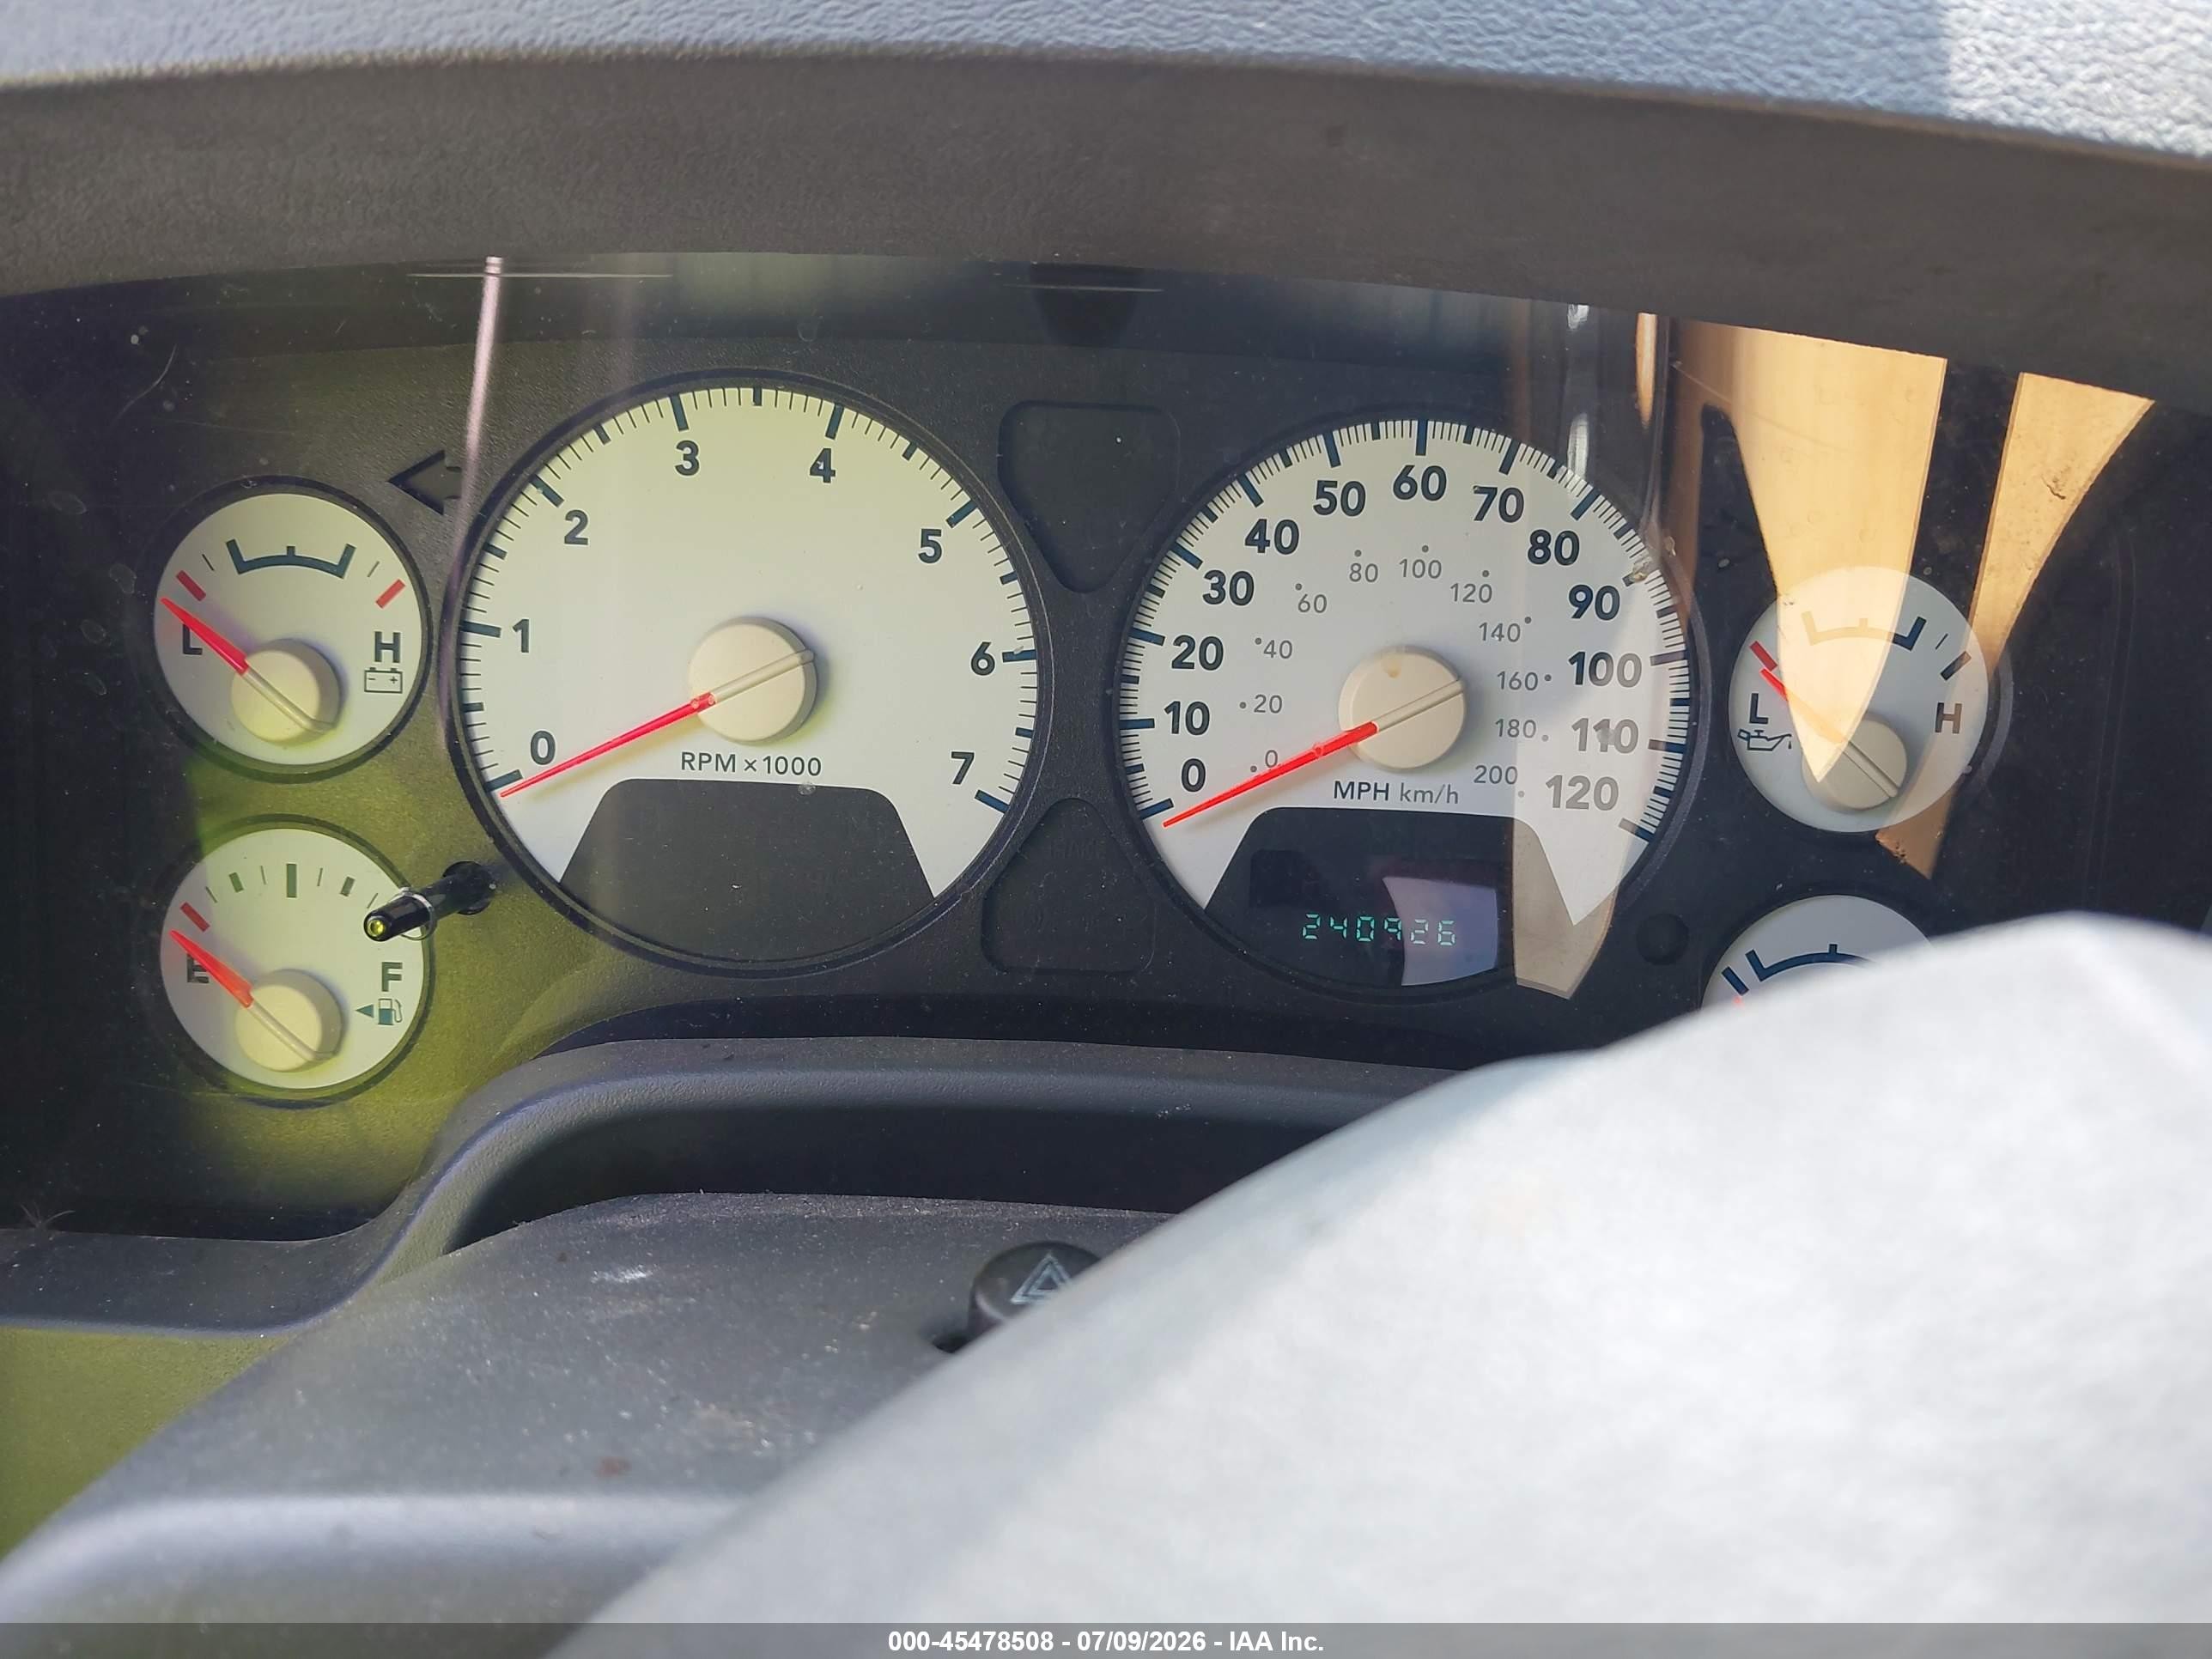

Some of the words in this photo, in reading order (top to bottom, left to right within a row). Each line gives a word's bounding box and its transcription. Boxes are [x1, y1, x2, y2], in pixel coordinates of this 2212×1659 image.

[675, 440, 700, 476] 3
[809, 448, 836, 483] 4
[1313, 480, 1366, 516] 50
[1393, 465, 1447, 501] 60
[1473, 486, 1524, 523] 70
[564, 509, 589, 545] 2
[1244, 519, 1299, 554] 40
[918, 528, 943, 563] 5
[1527, 530, 1580, 565] 80
[1349, 562, 1379, 584] 80
[1399, 559, 1442, 580] 100
[1203, 569, 1255, 605] 30
[1297, 593, 1328, 614] 60
[1449, 582, 1493, 604] 120
[1568, 585, 1620, 621] 90
[182, 625, 203, 656] L
[374, 631, 401, 663] H
[512, 617, 530, 653] 1
[1263, 639, 1293, 660] 40
[1479, 623, 1522, 643] 140
[971, 641, 996, 676] 6
[1171, 635, 1224, 671] 20
[1568, 651, 1642, 688] 100
[1496, 671, 1538, 692] 160
[1164, 701, 1211, 736] 10
[1253, 694, 1284, 714] 20
[1750, 692, 1769, 724] L
[1935, 702, 1963, 734] H
[1495, 719, 1536, 739] 180
[1571, 717, 1639, 754] 110
[530, 730, 556, 765] 0
[681, 750, 738, 774] RPM
[1265, 750, 1279, 769] 0
[951, 751, 975, 785] 7
[1181, 758, 1206, 793] 0
[1474, 764, 1518, 786] 200
[1333, 780, 1390, 803] MPH
[1400, 782, 1460, 805] km/h
[1546, 774, 1619, 811] 120
[1302, 913, 1456, 946] 240926
[186, 953, 210, 984] E
[381, 961, 404, 991] F
